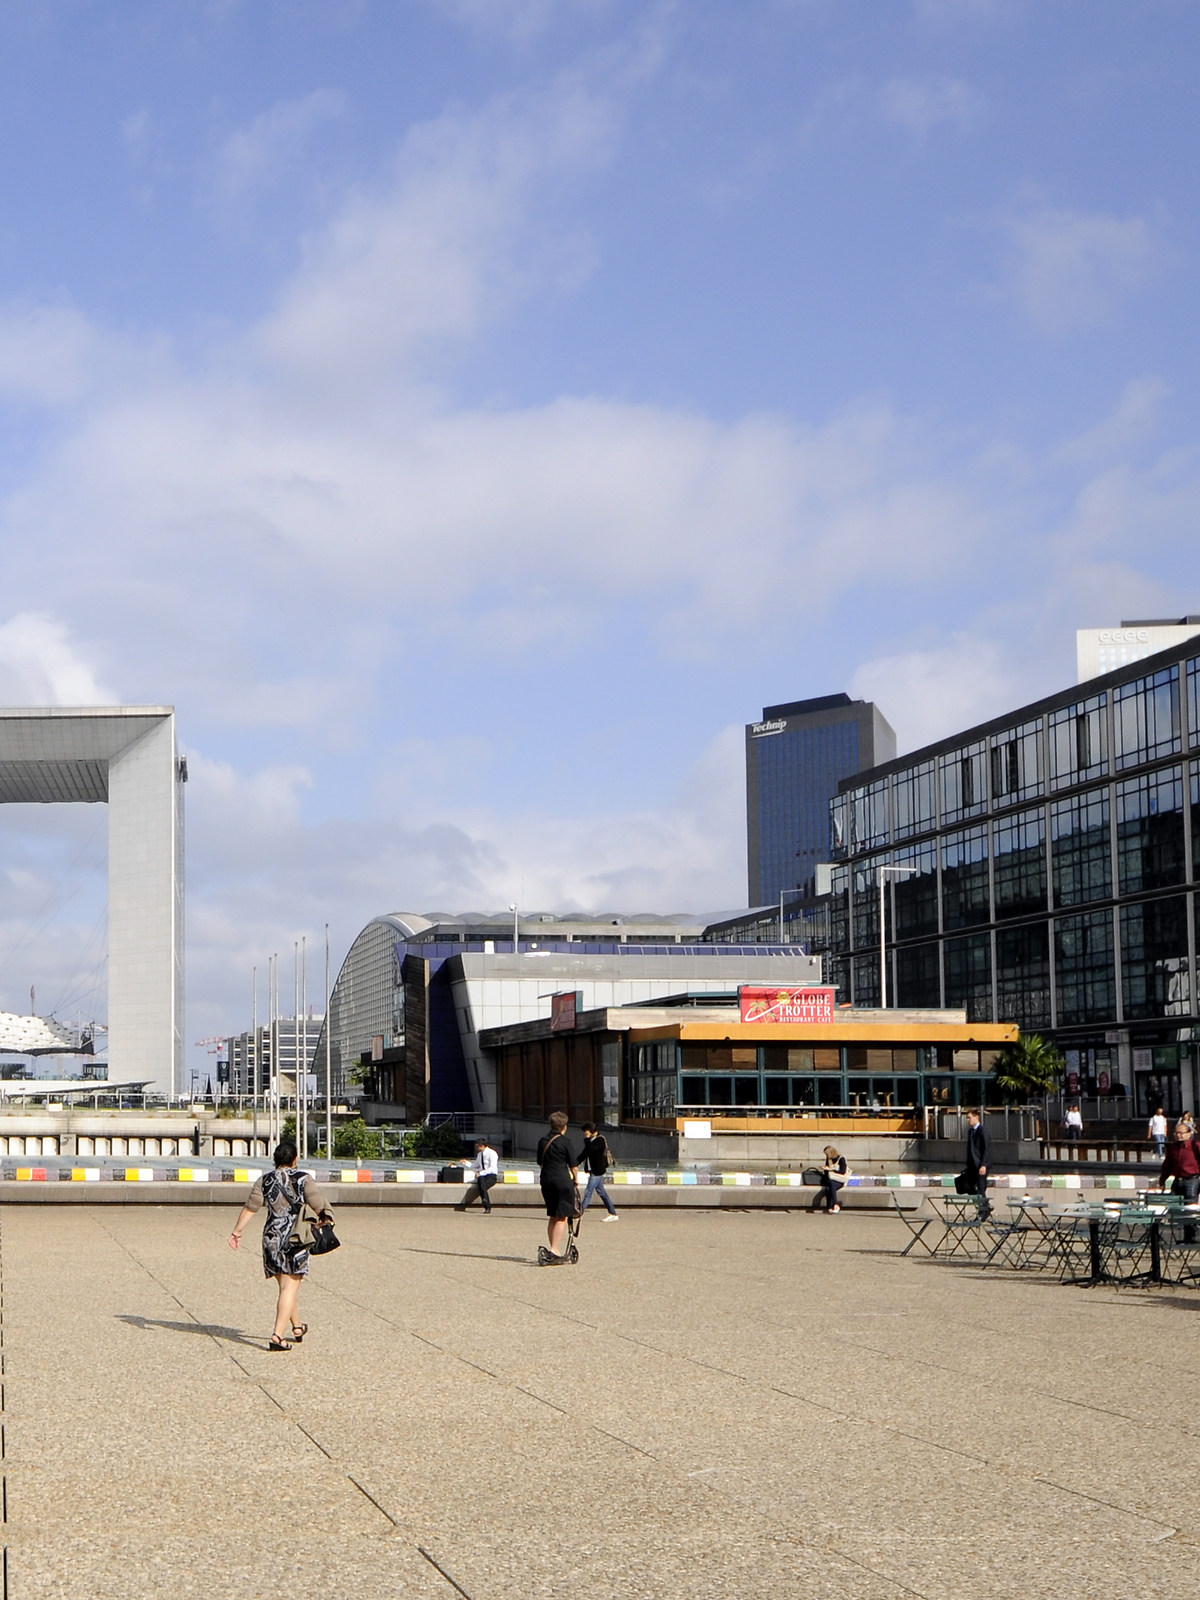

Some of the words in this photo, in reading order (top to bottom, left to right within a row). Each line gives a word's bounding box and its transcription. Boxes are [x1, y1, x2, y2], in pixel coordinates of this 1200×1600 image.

[751, 718, 788, 733] Technip
[793, 994, 831, 1006] GLOBE
[779, 1005, 831, 1017] TROTTER
